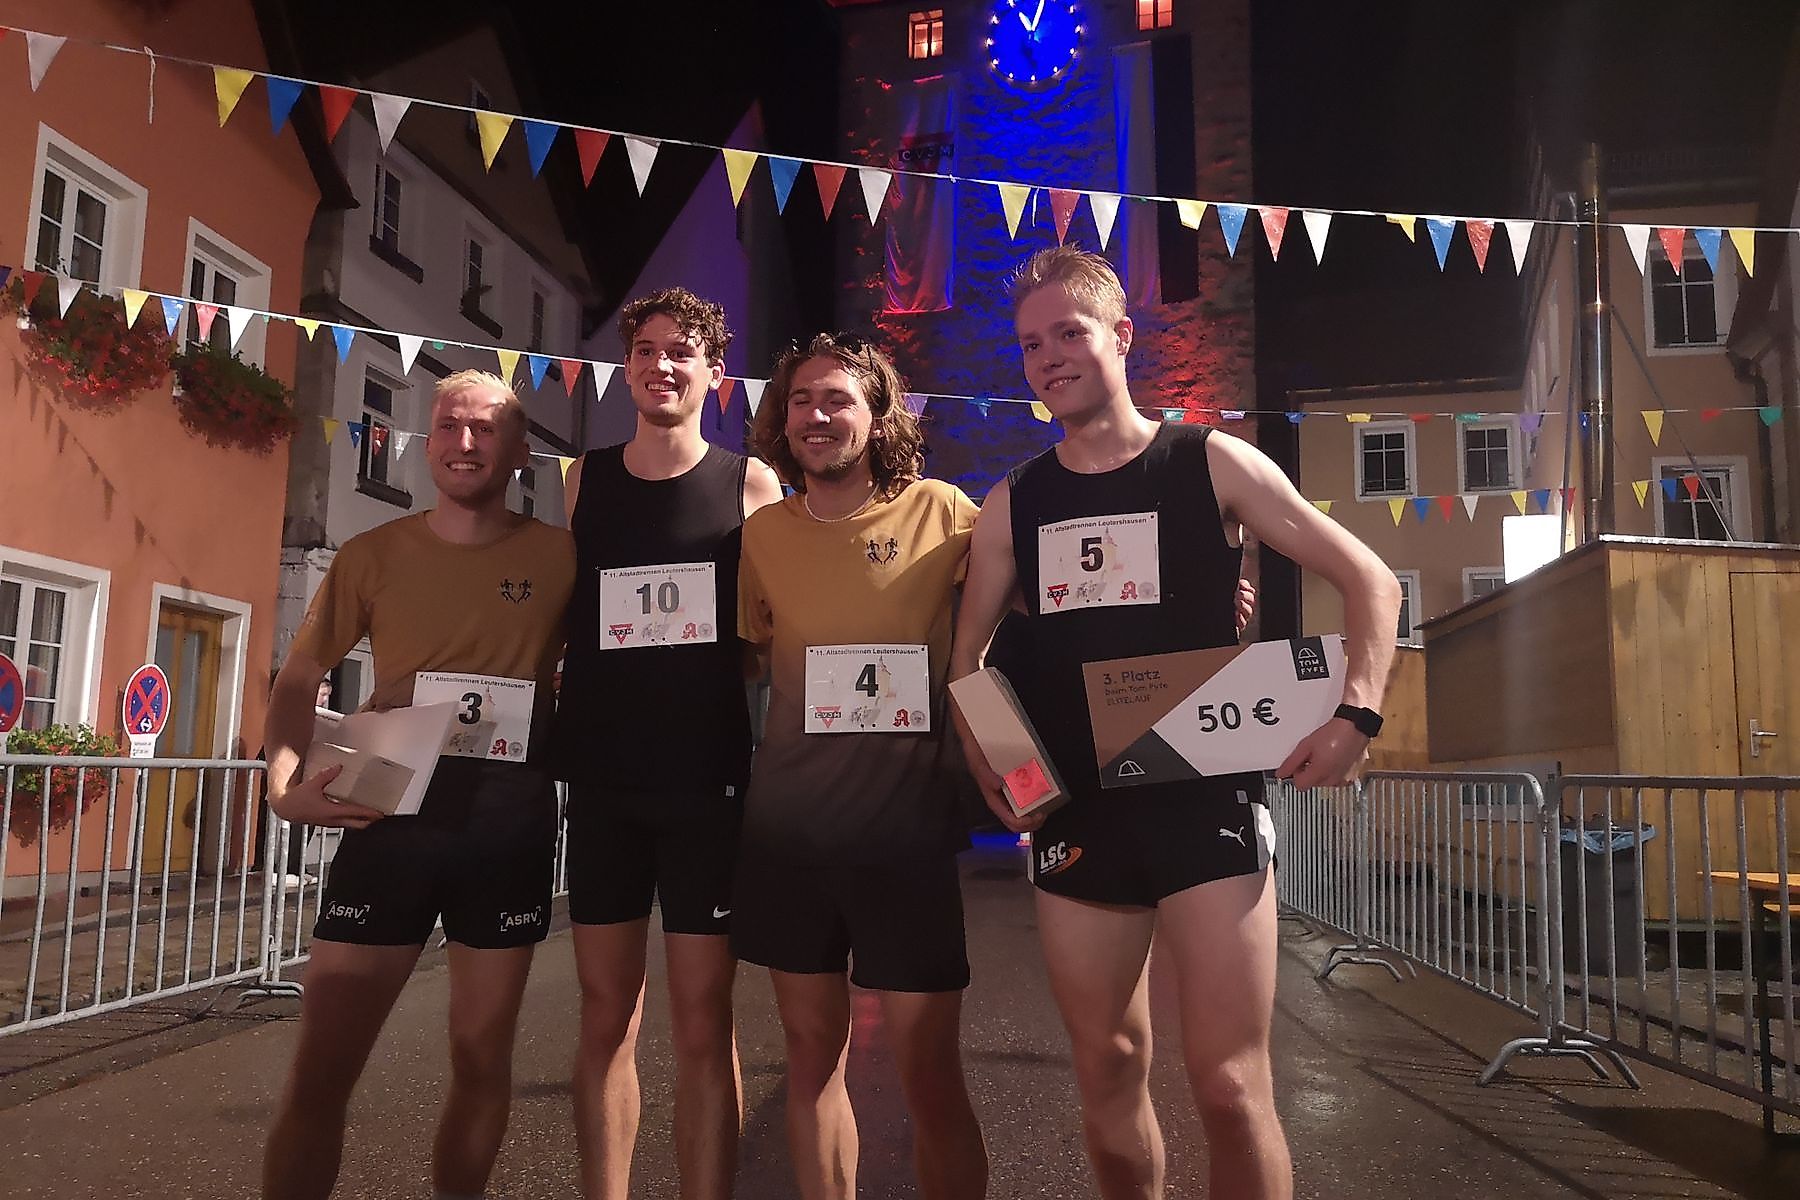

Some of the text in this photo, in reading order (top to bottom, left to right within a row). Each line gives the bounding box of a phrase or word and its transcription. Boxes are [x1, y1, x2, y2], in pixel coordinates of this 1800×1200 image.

[1055, 522, 1097, 533] Altstadtrennen
[1098, 518, 1147, 527] Leutershausen
[1081, 537, 1103, 572] 5
[619, 569, 661, 577] Altstadtrennen
[662, 566, 706, 574] Leutershausen
[636, 582, 680, 614] 10
[1048, 589, 1069, 598] CVJM
[608, 628, 634, 636] CVJM
[1299, 659, 1319, 667] TOM
[1301, 666, 1325, 675] FYFE
[480, 680, 526, 689] Leutershausen
[856, 664, 879, 697] 4
[1103, 670, 1161, 685] 3. Platz
[1128, 684, 1147, 692] Tom
[459, 692, 482, 724] 3
[815, 711, 841, 719] CVJM
[1198, 698, 1280, 732] 50 €
[1040, 841, 1067, 870] LSC
[328, 904, 364, 919] ASRV
[505, 910, 539, 927] ASRV
